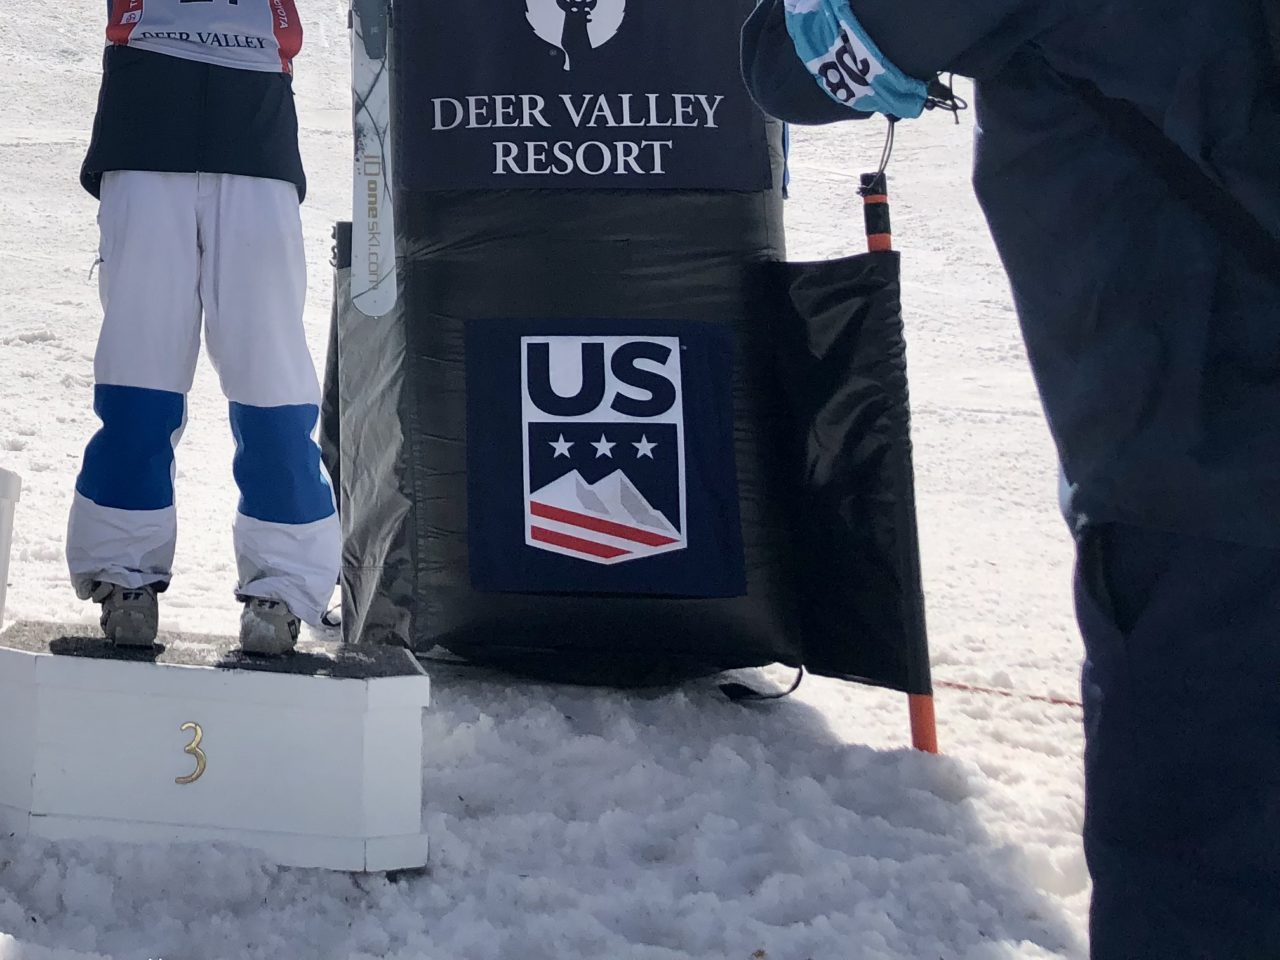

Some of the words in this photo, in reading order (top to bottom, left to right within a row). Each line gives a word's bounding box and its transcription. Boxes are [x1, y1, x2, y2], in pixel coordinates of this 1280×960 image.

[196, 32, 269, 49] VALLEY
[431, 94, 551, 131] DEER
[559, 93, 724, 129] VALLEY
[492, 140, 672, 175] RESORT
[526, 341, 677, 418] US
[175, 722, 207, 786] 3
